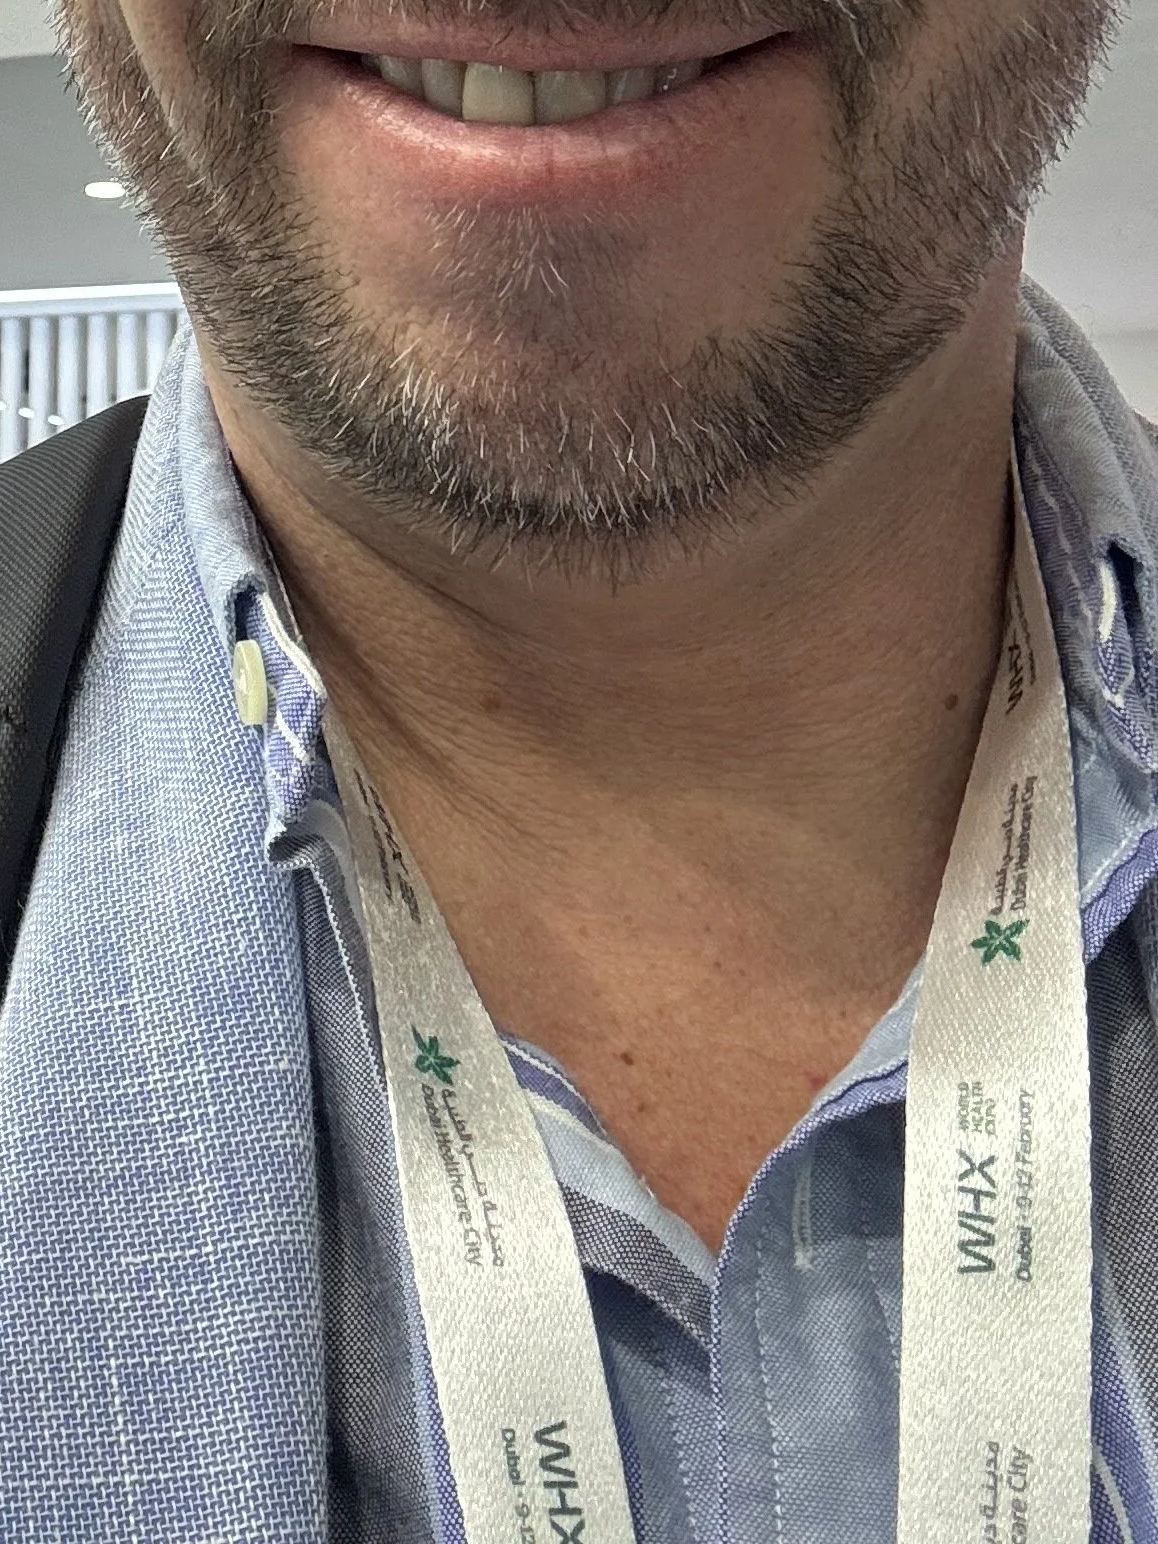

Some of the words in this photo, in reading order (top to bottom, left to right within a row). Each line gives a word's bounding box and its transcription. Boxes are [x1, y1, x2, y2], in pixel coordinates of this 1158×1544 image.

[1015, 1086, 1036, 1166] February
[956, 1148, 997, 1274] WHX
[463, 1226, 483, 1268] City
[1015, 1225, 1032, 1283] Dubai
[500, 1427, 527, 1486] Dubai
[1006, 1443, 1034, 1493] City
